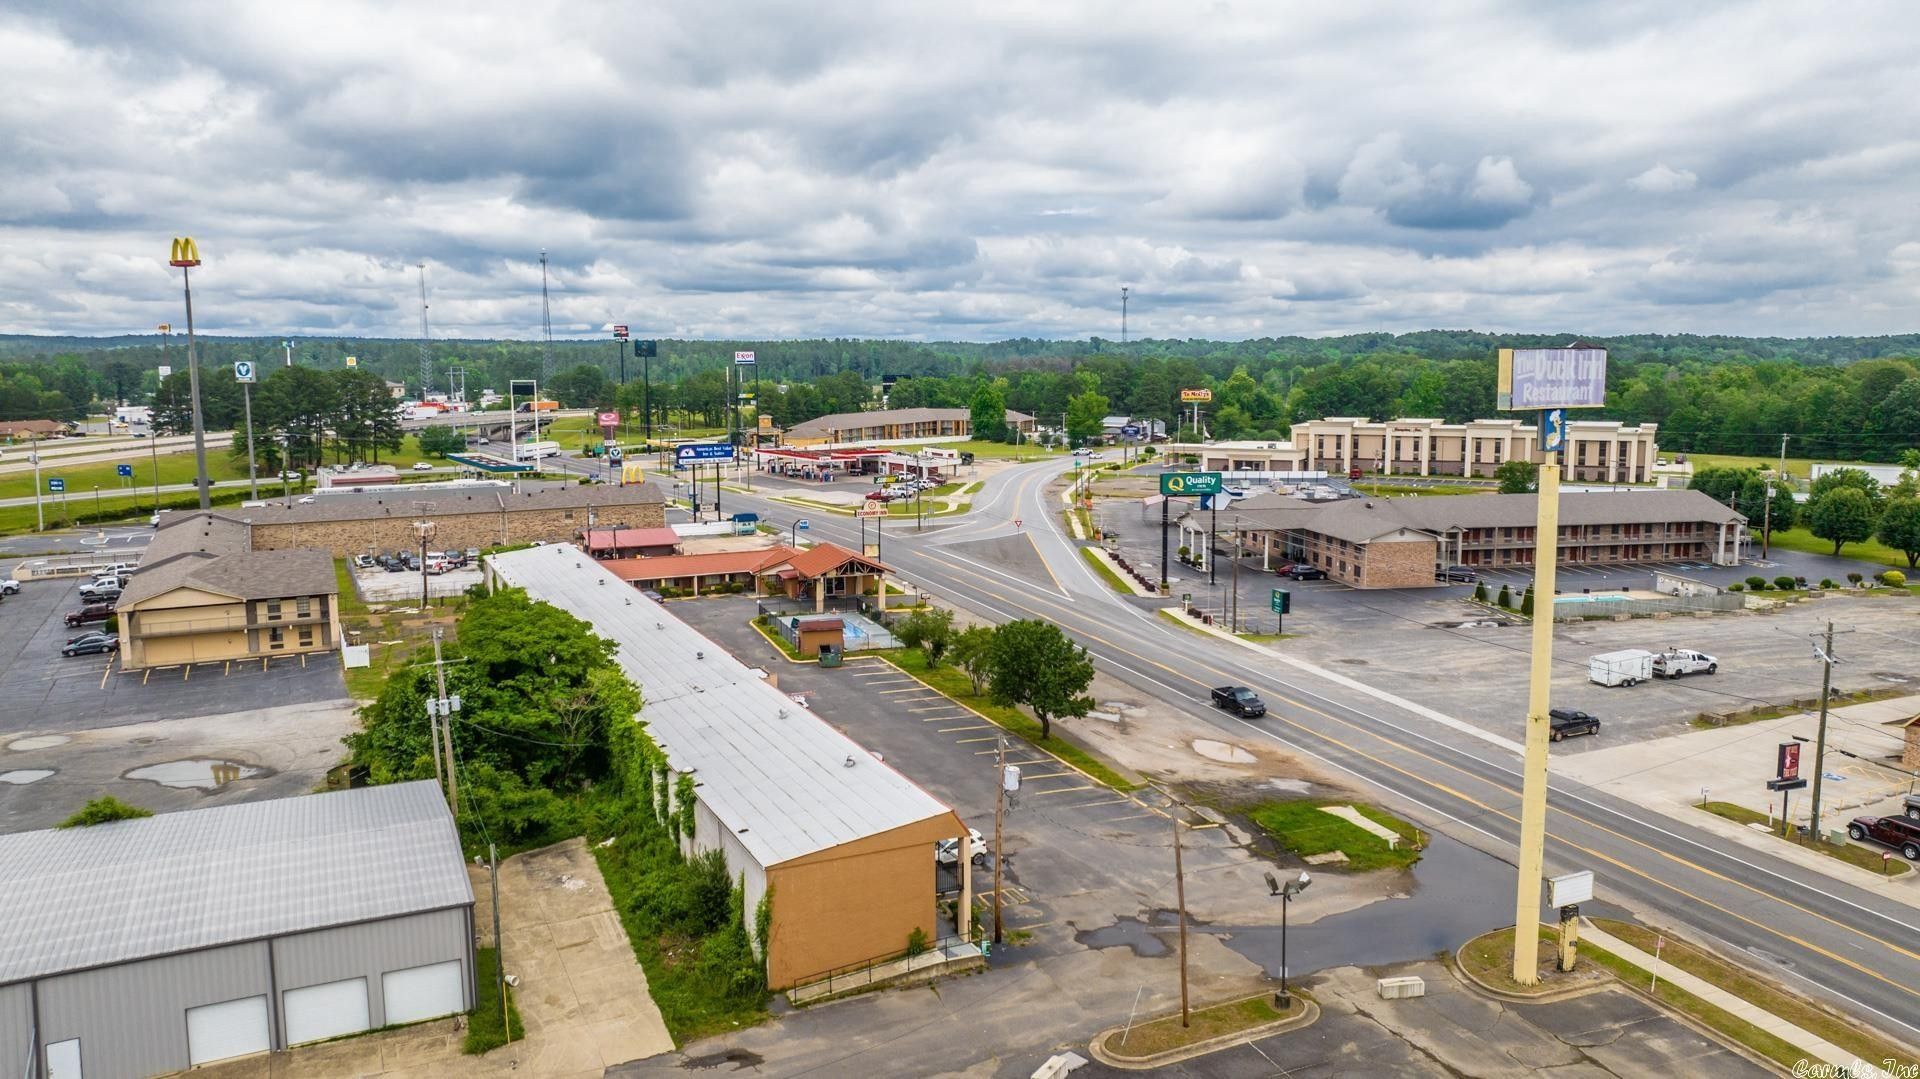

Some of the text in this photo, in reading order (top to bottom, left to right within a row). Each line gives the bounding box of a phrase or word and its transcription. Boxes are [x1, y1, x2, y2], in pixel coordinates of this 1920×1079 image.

[1535, 350, 1575, 380] Duck
[1523, 382, 1593, 402] Restaurant
[1185, 475, 1217, 485] Quality
